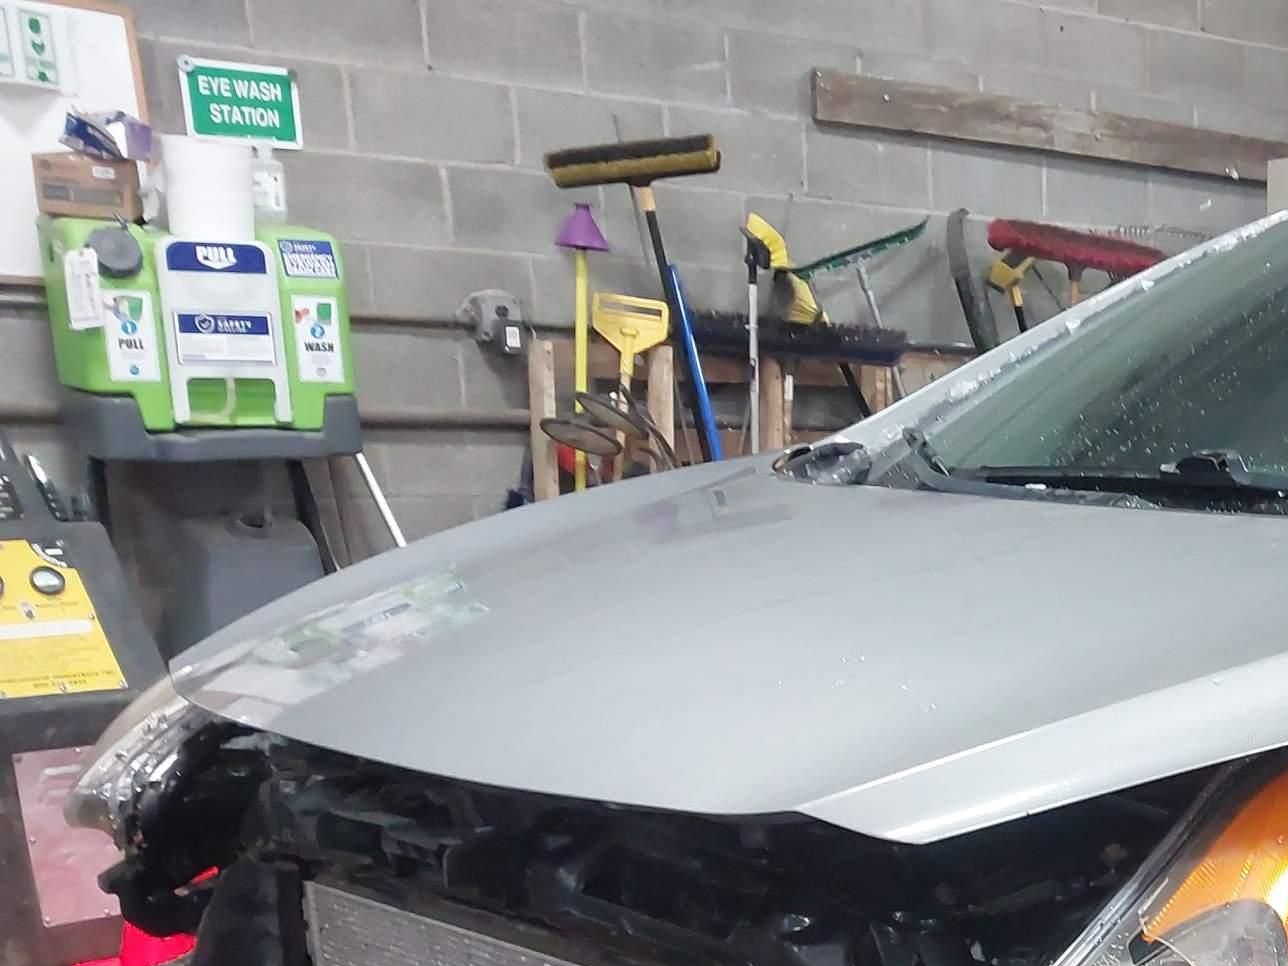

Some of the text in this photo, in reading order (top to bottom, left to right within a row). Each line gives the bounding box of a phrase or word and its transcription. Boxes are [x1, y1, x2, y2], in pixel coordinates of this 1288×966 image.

[197, 74, 282, 102] EYE WASH
[209, 102, 280, 128] STATION
[195, 246, 237, 264] PULL
[118, 338, 144, 350] PULL
[304, 342, 335, 352] WASH
